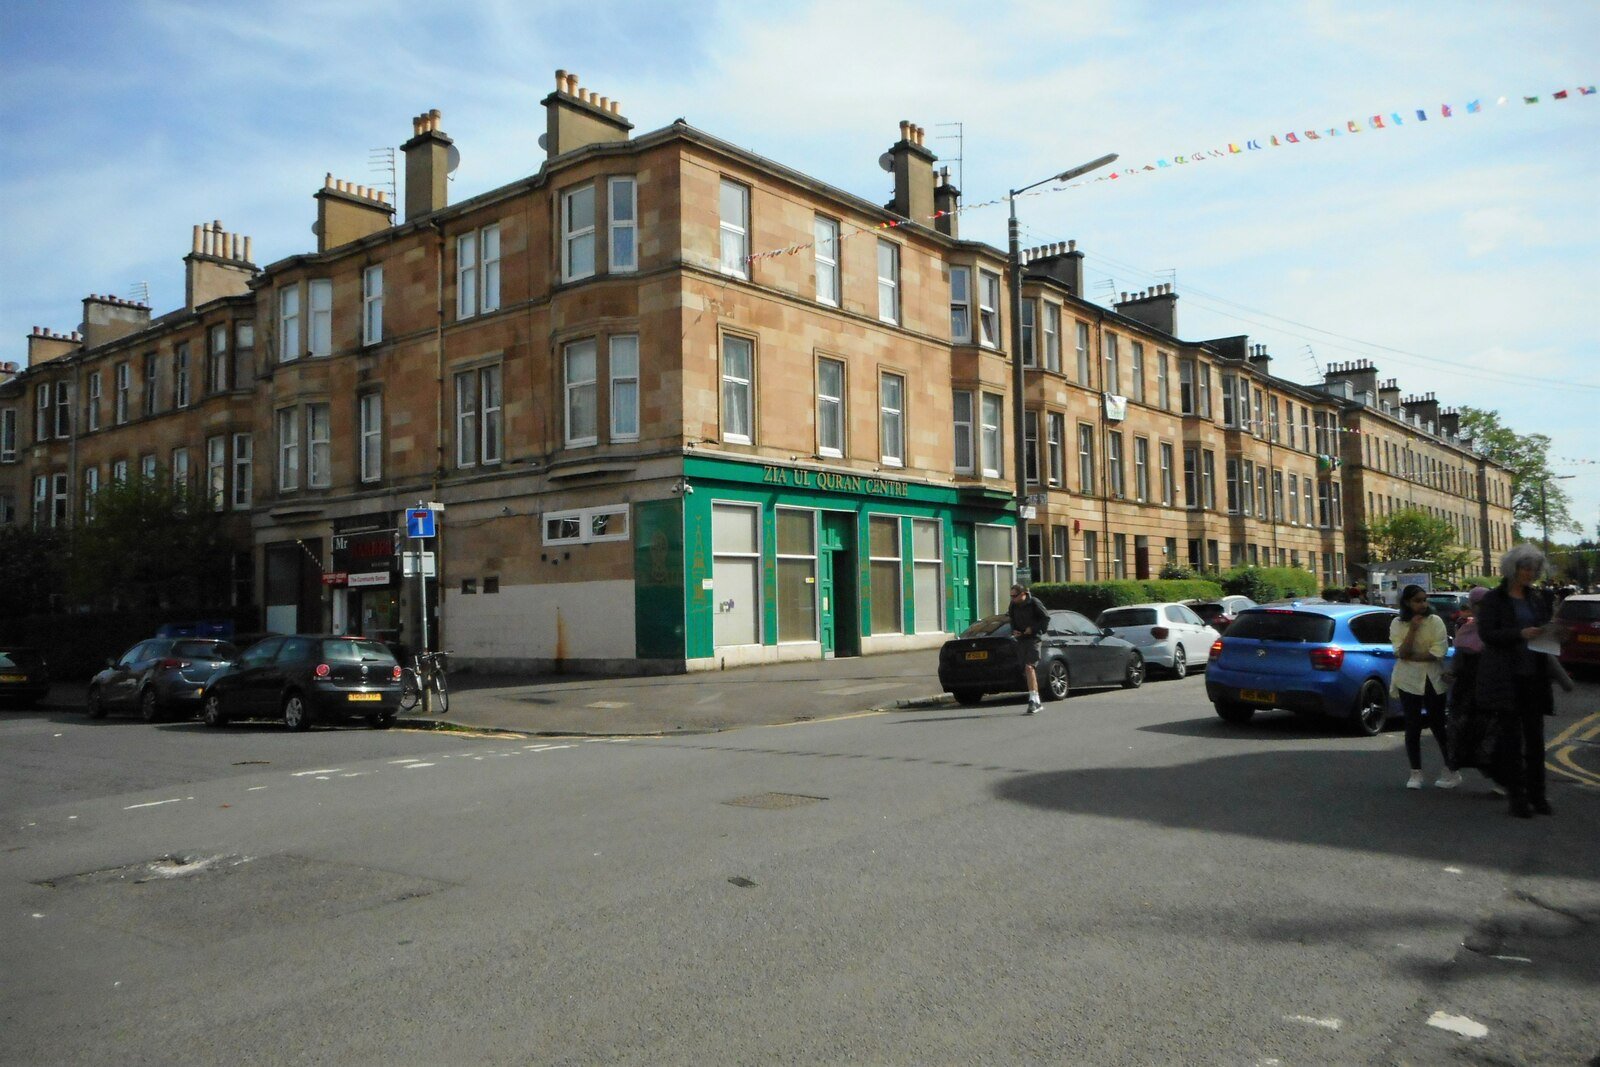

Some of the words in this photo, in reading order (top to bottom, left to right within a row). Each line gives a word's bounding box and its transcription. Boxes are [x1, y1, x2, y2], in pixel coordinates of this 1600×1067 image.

[763, 466, 787, 484] ZIA
[793, 469, 811, 486] UL
[816, 472, 861, 491] QURAN
[865, 479, 908, 497] CENTRE
[336, 537, 348, 549] Mr
